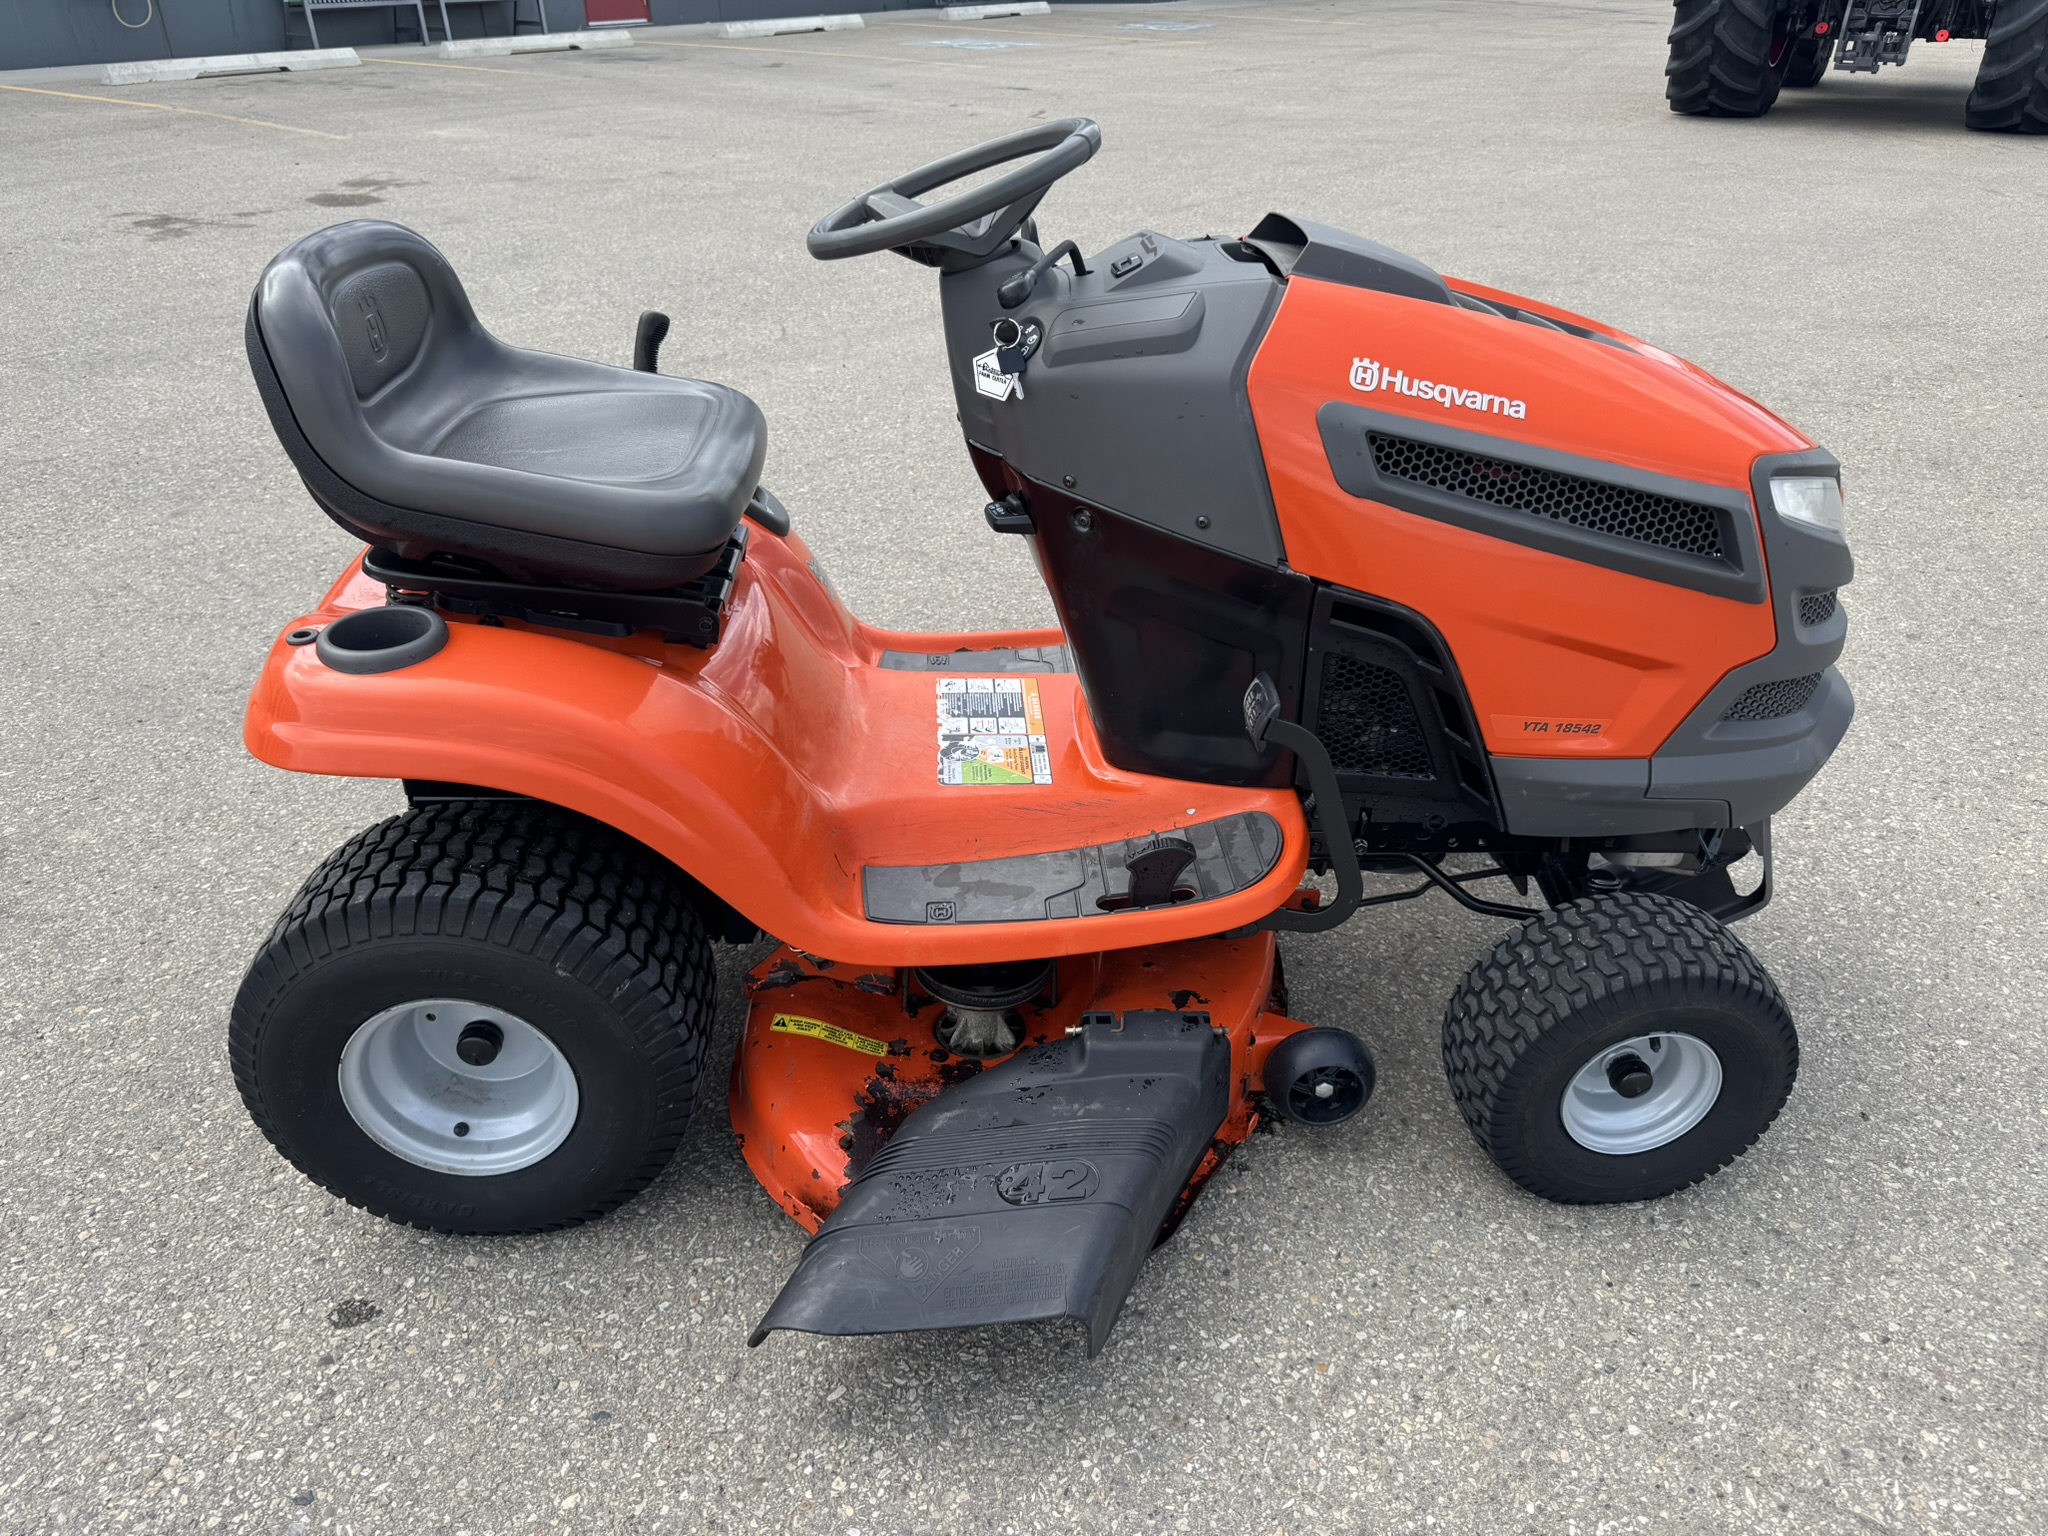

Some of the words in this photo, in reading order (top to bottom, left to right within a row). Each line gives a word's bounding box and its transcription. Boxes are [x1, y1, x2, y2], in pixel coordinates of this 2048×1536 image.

[1379, 367, 1527, 420] Husqvarna
[1523, 721, 1549, 733] YTA
[1555, 723, 1602, 735] 18542
[999, 1161, 1090, 1202] 42
[863, 1238, 883, 1248] KEEP
[915, 1246, 964, 1297] DANGER
[993, 1256, 1027, 1269] CAUTION
[973, 1268, 1020, 1283] DEFLECTOR
[1022, 1264, 1051, 1278] SHIELD
[944, 1284, 972, 1298] ENTIRE
[974, 1281, 1003, 1296] GRASS
[1005, 1277, 1042, 1293] CATCHER
[945, 1299, 957, 1310] BE
[969, 1296, 994, 1308] PLACE
[997, 1292, 1025, 1305] WHILE
[1026, 1286, 1061, 1302] MOWING
